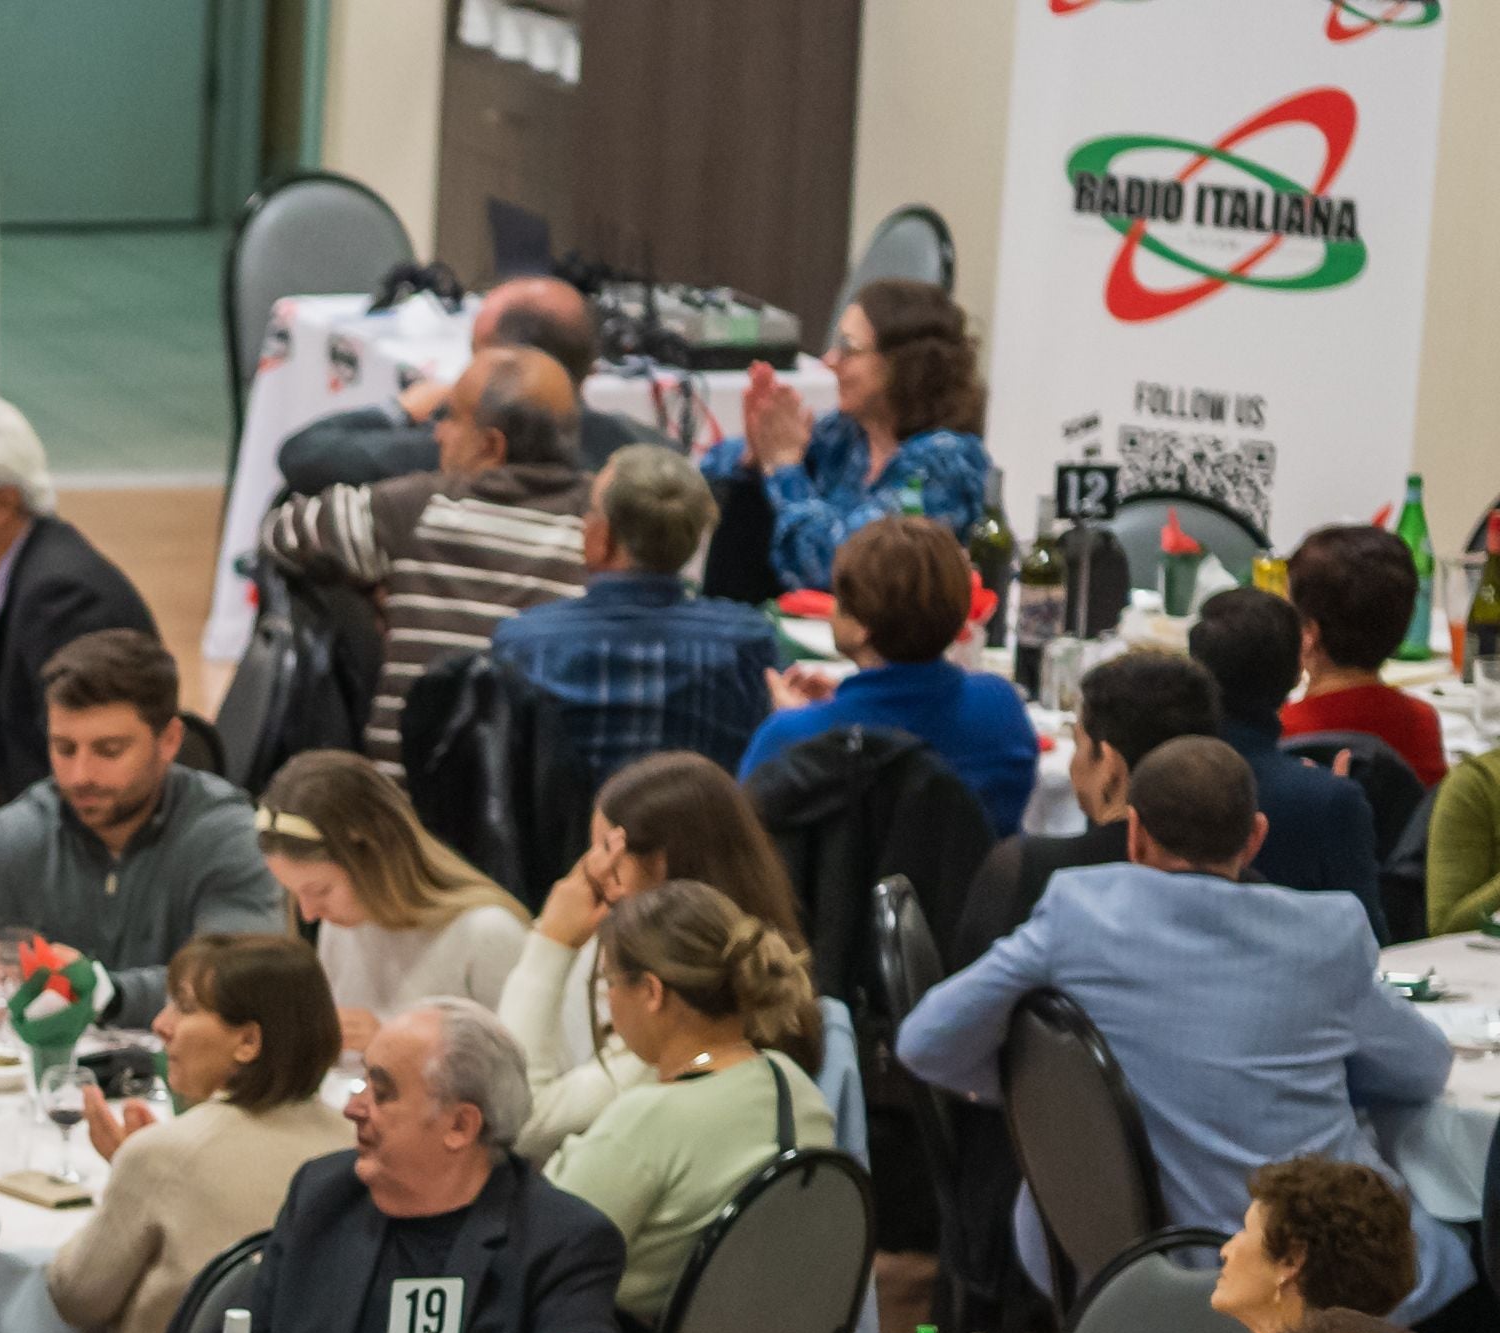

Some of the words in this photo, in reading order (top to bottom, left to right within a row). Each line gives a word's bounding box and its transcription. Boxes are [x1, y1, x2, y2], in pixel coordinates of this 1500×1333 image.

[1074, 171, 1185, 224] RADIO
[1195, 184, 1359, 241] ITALIANA
[1135, 380, 1229, 423] FOLLOW
[1235, 394, 1268, 429] US
[1063, 470, 1110, 516] 12
